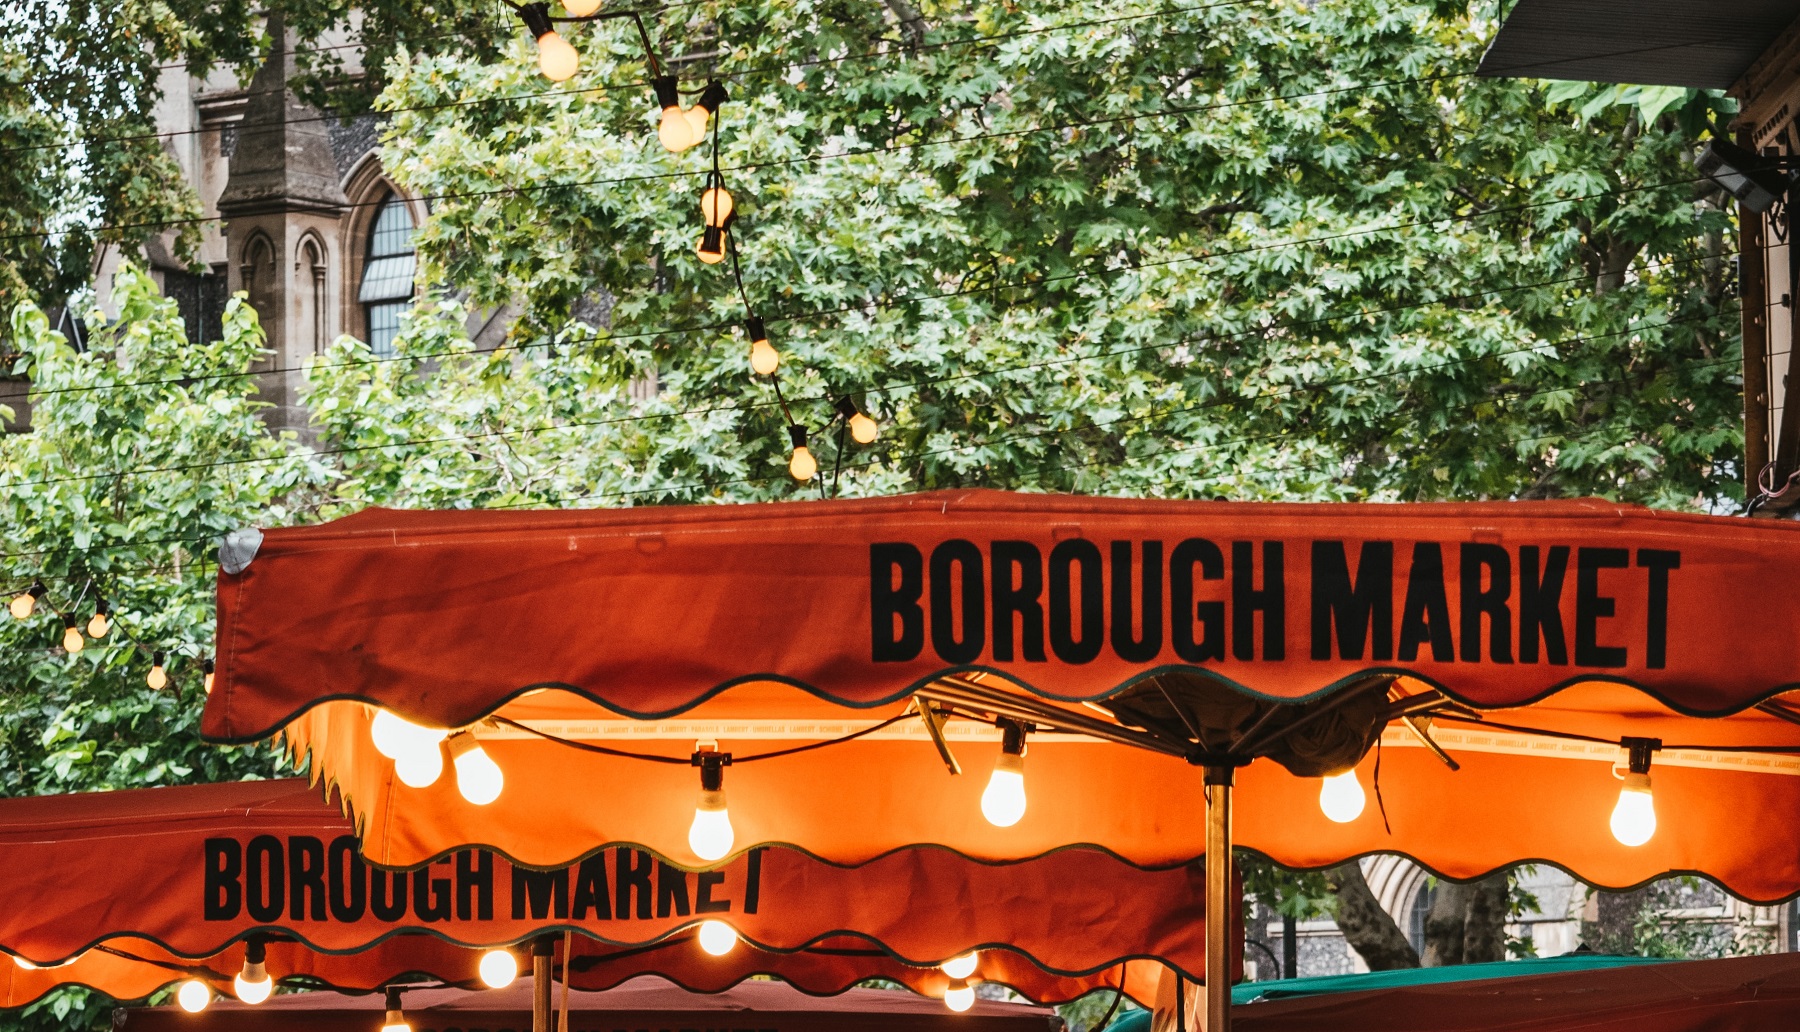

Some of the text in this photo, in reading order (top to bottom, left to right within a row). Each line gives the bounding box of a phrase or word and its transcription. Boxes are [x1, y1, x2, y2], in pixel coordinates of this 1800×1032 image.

[871, 539, 1681, 669] BOROUGH MARKET
[204, 835, 494, 923] BOROUGH
